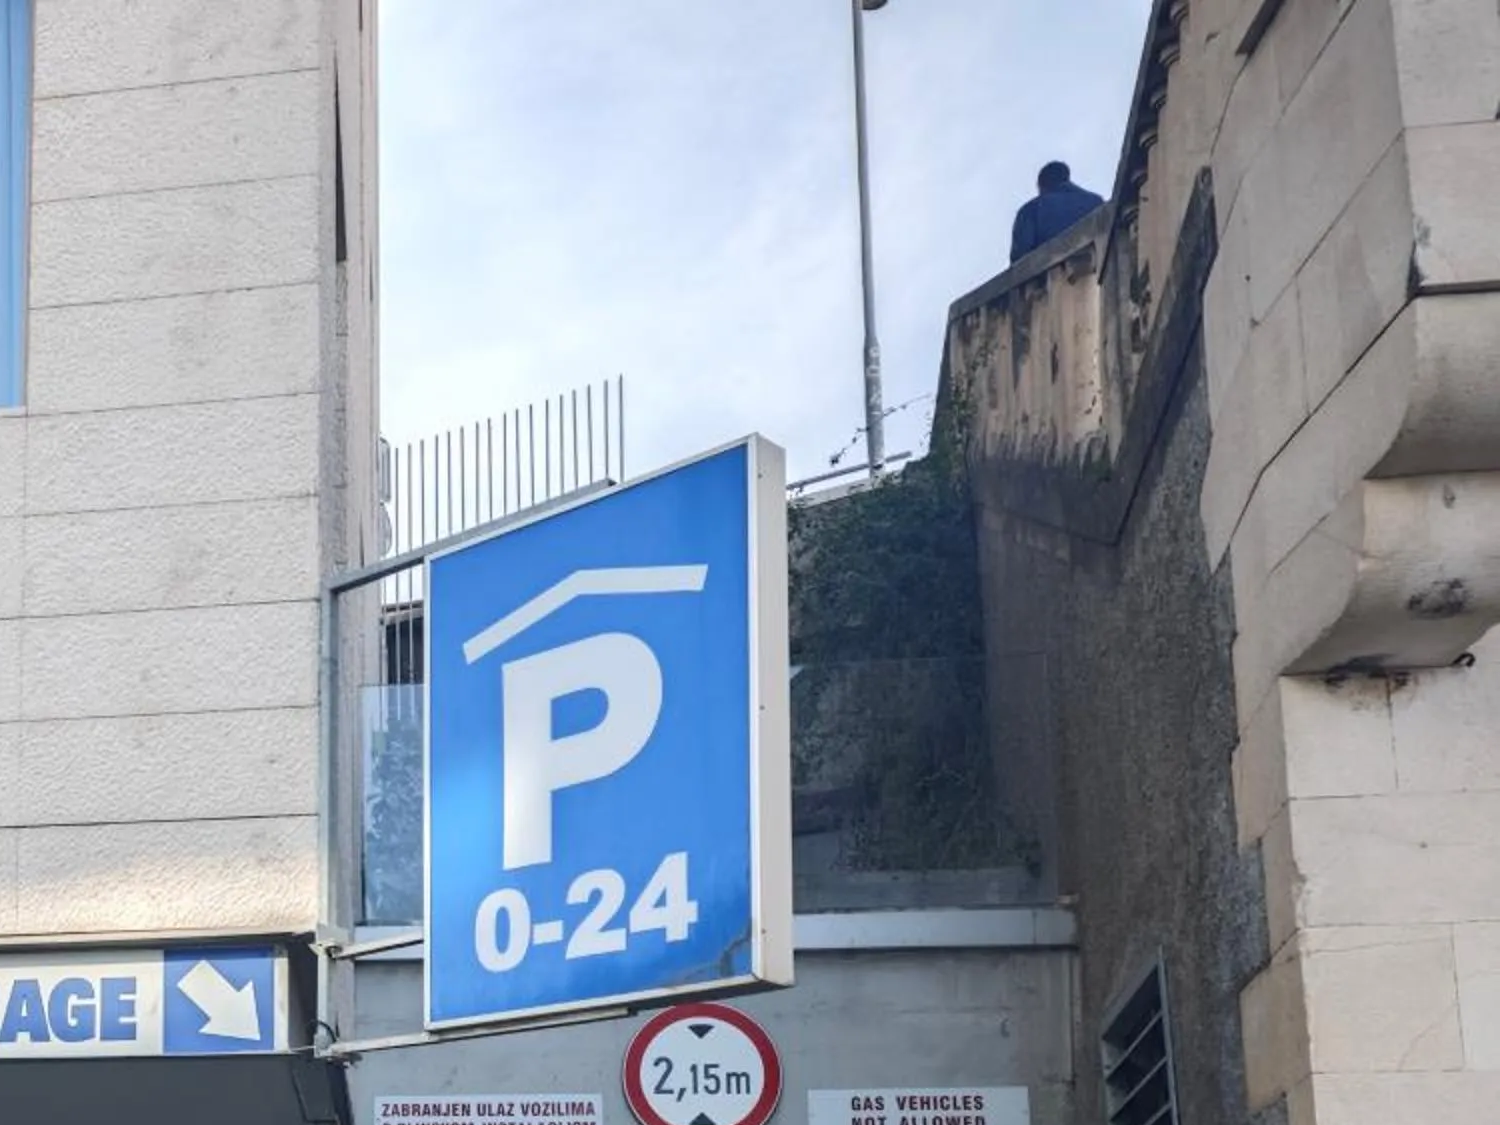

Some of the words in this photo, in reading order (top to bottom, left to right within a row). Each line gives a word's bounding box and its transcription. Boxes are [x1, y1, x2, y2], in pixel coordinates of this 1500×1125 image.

[503, 632, 663, 870] P
[475, 852, 698, 972] 0-24
[652, 1057, 751, 1102] 2,15m
[381, 1103, 471, 1118] ZABRANJEN
[476, 1102, 515, 1117] ULAZ
[520, 1101, 596, 1117] VOZILIMA
[850, 1096, 885, 1112] GAS
[897, 1095, 985, 1112] VEHICLES
